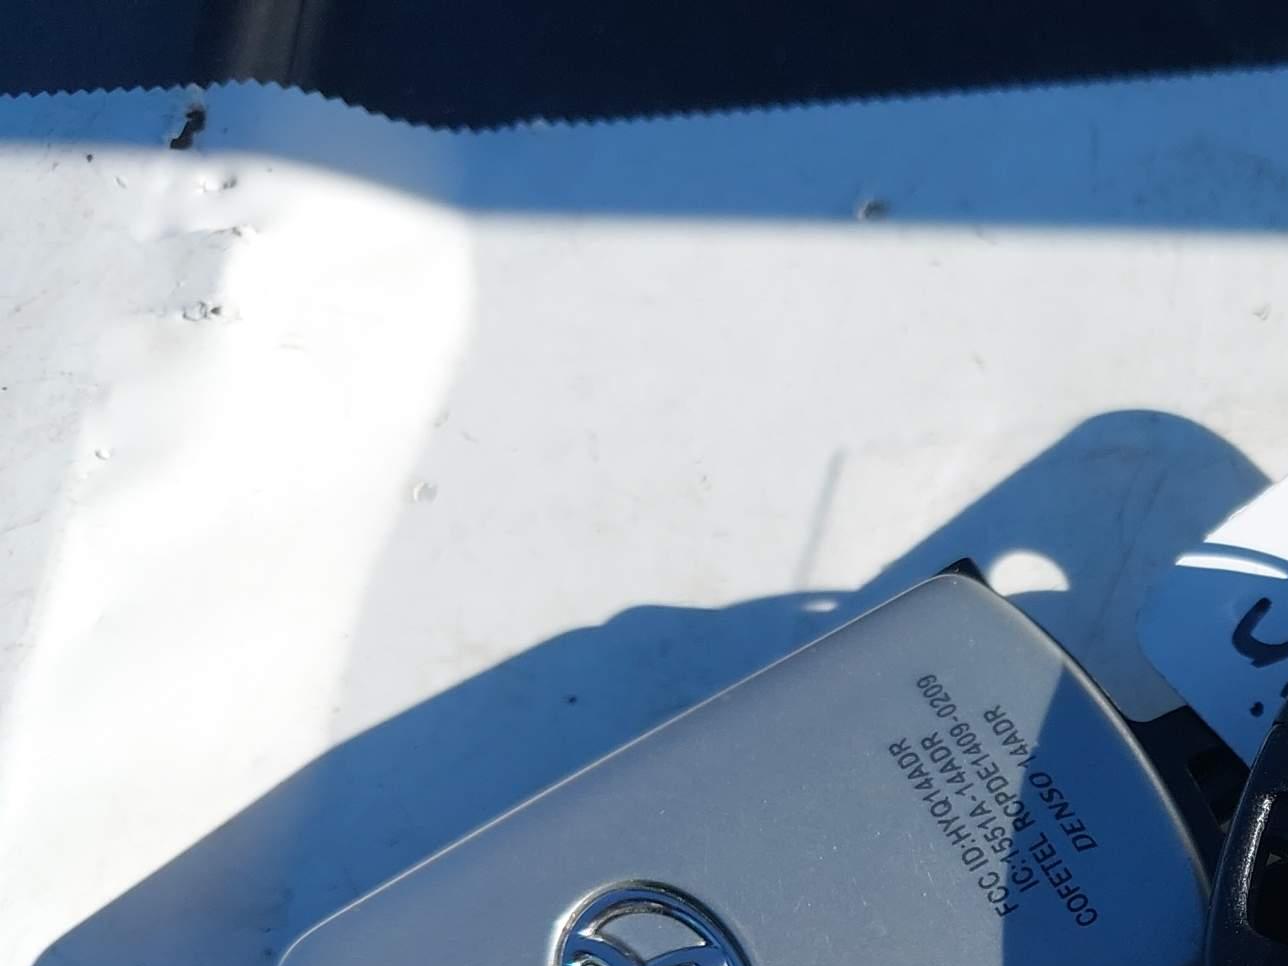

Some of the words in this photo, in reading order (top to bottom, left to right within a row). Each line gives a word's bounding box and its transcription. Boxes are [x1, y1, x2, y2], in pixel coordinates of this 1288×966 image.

[916, 674, 1035, 833] RCPDE1409-0209
[984, 704, 1037, 769] 14ADR
[889, 738, 989, 872] ID:HYQ14ADR
[921, 732, 1040, 892] IC:1551A-14ADR
[1029, 772, 1098, 853] DENSO
[978, 871, 1019, 917] FCC
[1029, 832, 1098, 927] COFETEL
